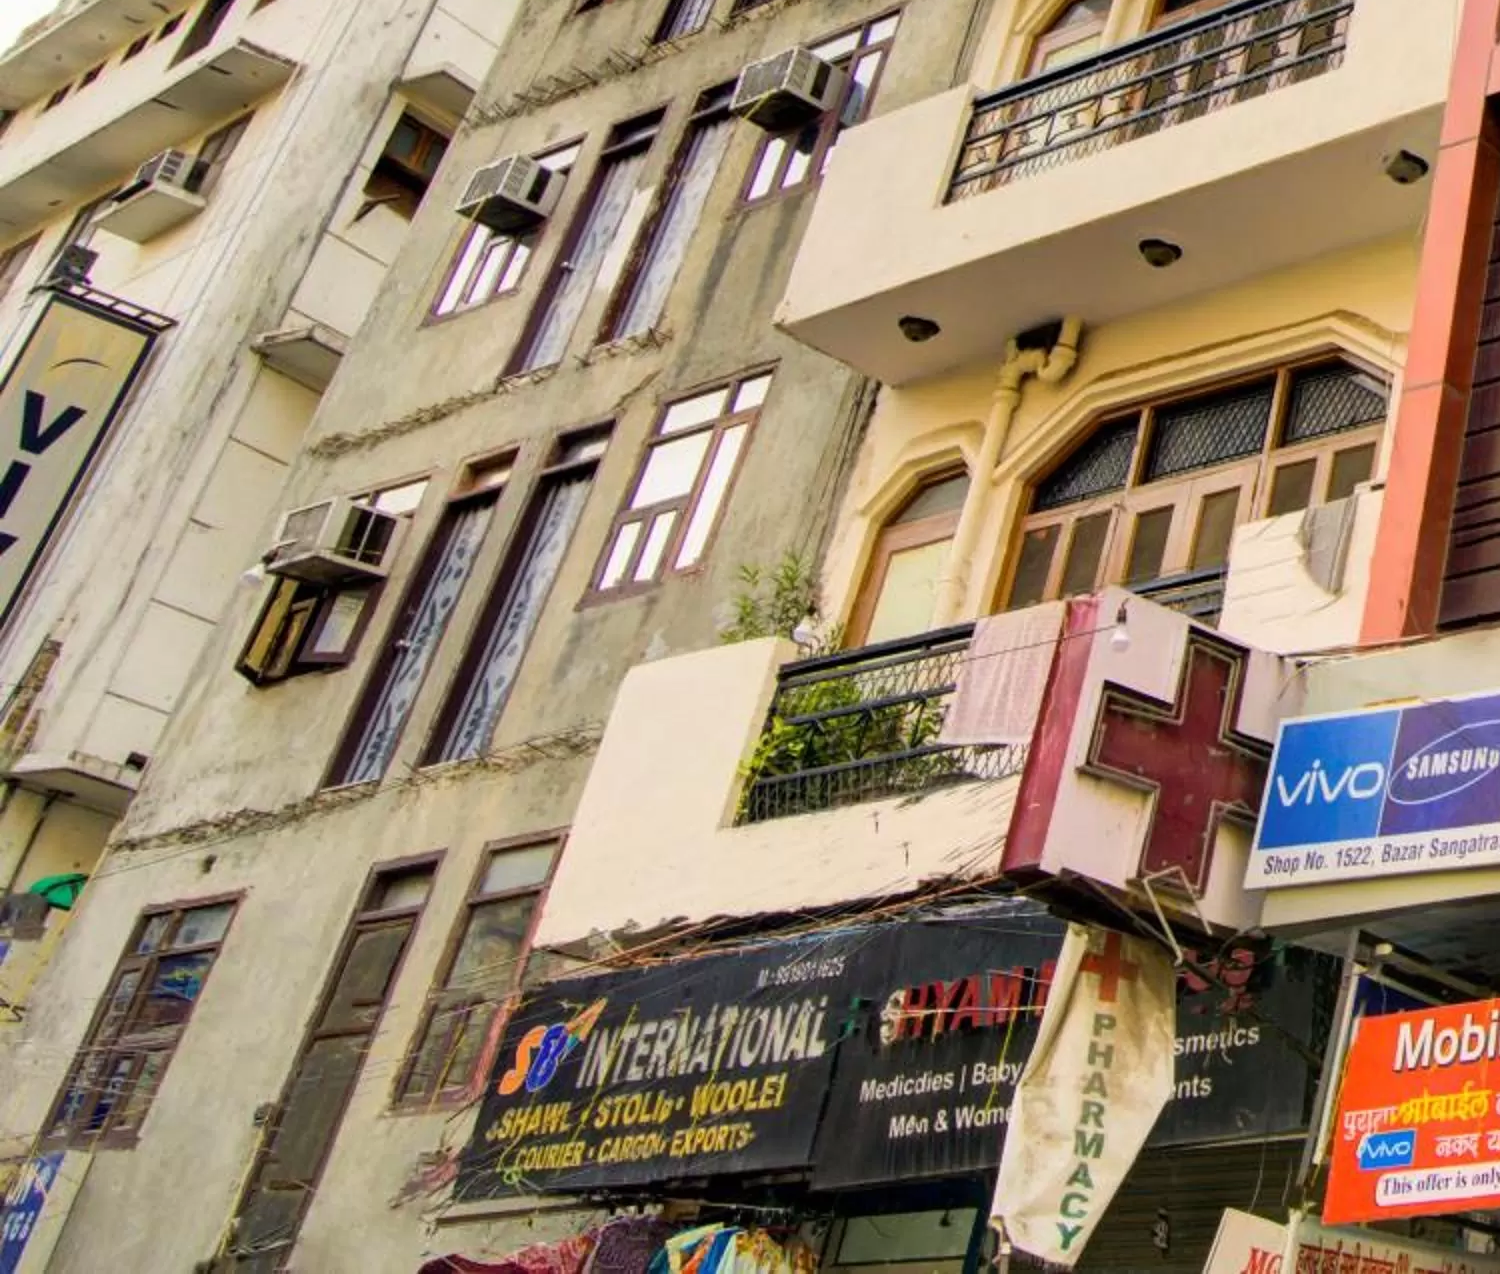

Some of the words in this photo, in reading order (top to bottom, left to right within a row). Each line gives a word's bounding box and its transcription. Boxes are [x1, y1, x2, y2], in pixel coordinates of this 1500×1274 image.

[1263, 854, 1301, 877] Shop
[1303, 850, 1329, 872] No.
[1336, 844, 1376, 868] 1522,
[1381, 839, 1425, 864] Bazar
[971, 1061, 1023, 1086] Baby
[934, 1109, 949, 1132] &
[1055, 1012, 1117, 1252] PHARMACY
[1382, 1173, 1412, 1196] This
[1455, 1170, 1468, 1187] is
